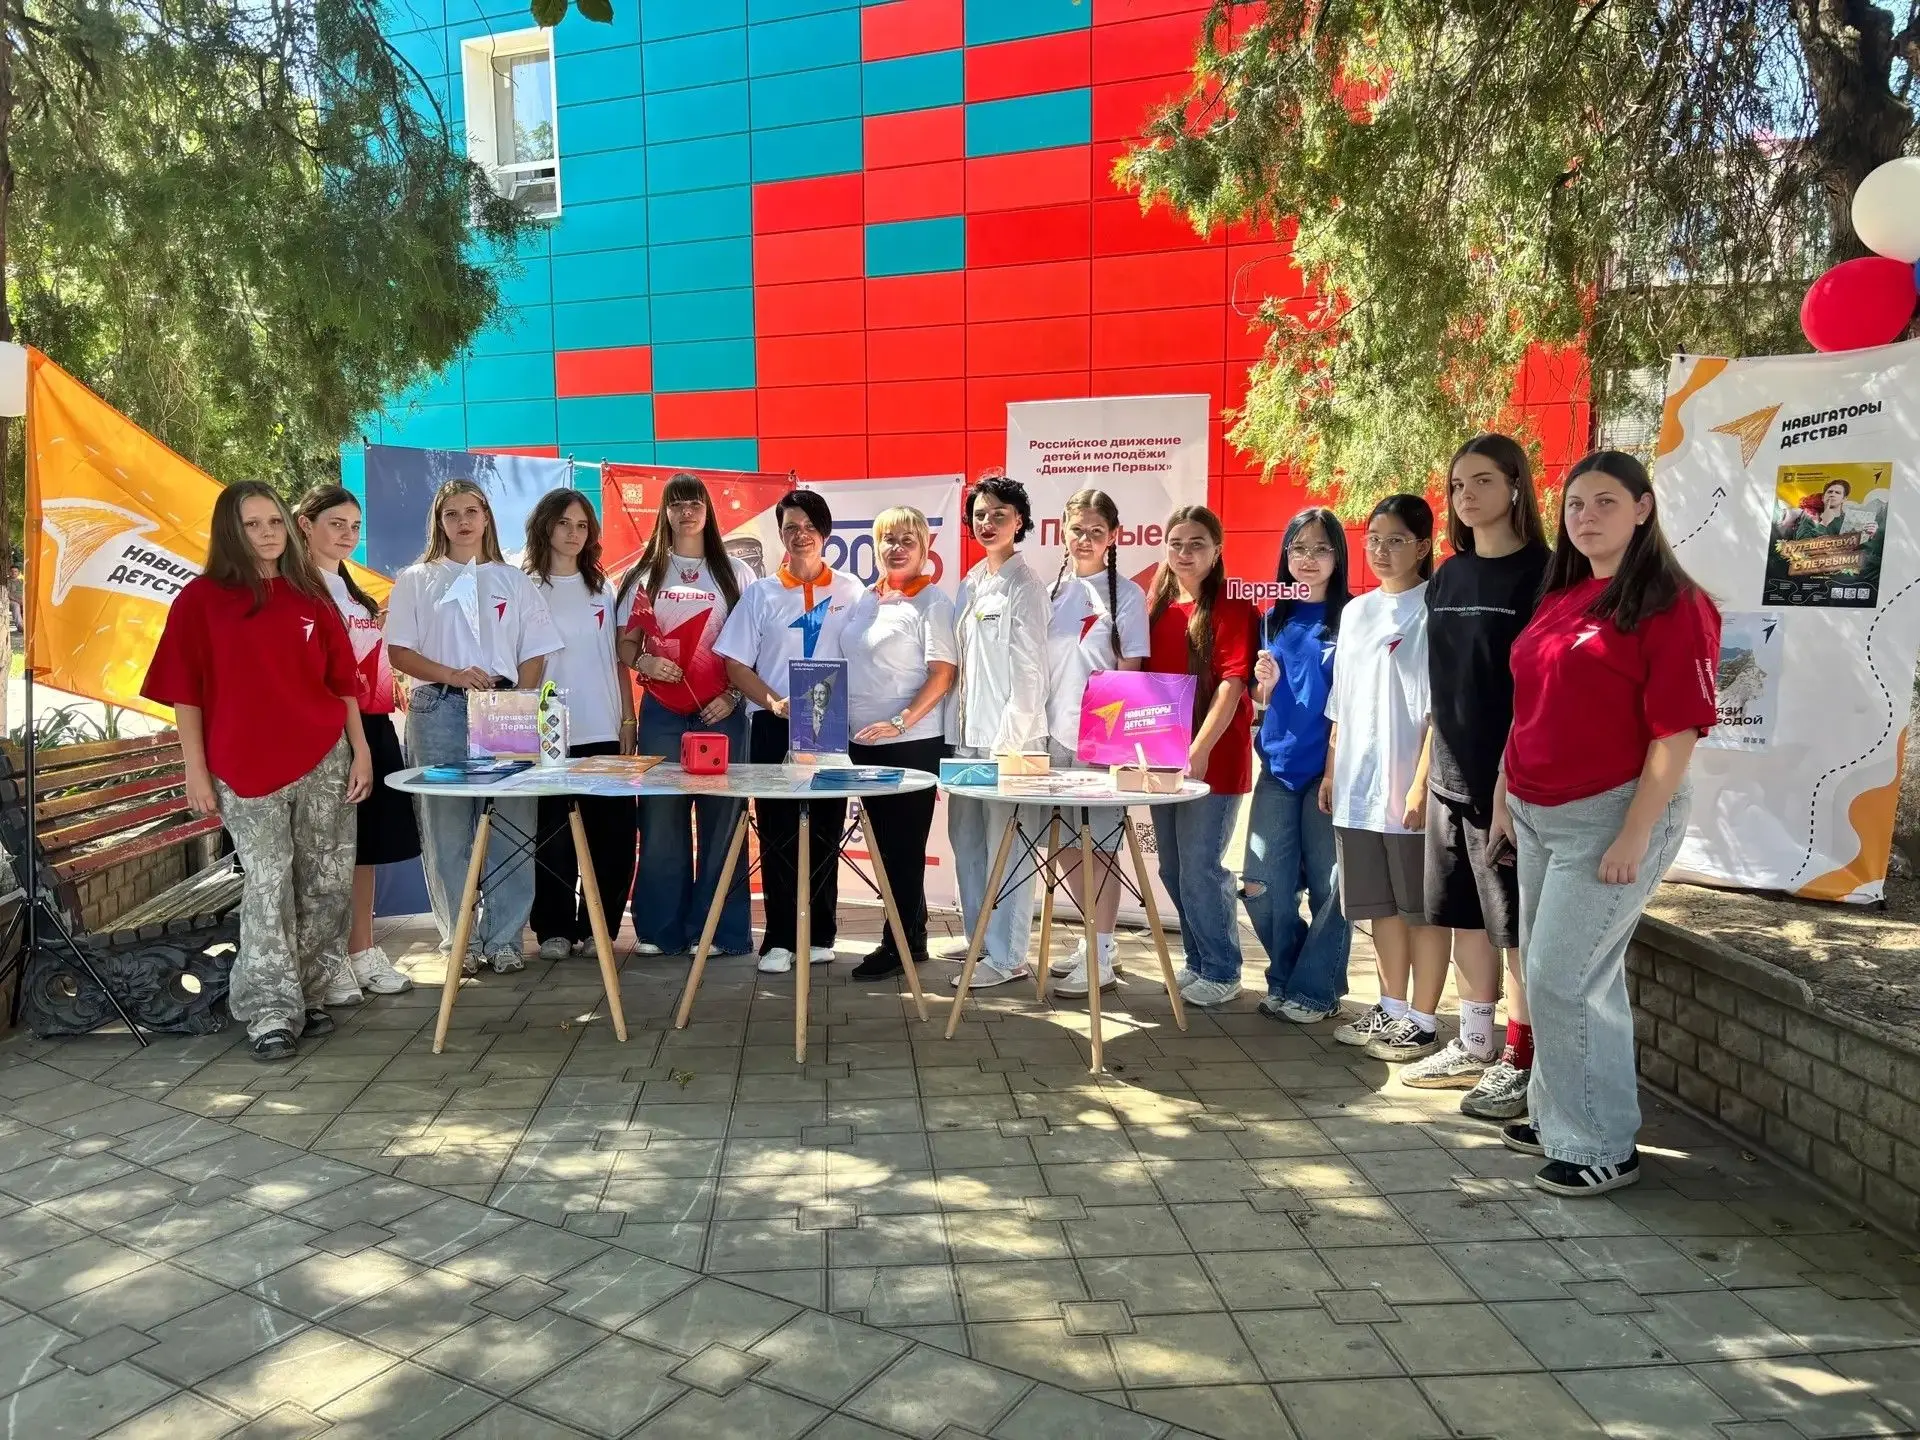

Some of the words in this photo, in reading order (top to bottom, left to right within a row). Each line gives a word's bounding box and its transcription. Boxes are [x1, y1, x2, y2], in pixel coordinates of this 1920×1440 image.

[1782, 401, 1882, 432] НАВИГАТОРЫ
[1029, 438, 1107, 450] Российское
[1110, 436, 1181, 447] движение
[1780, 423, 1848, 449] ДЕТСТВА
[1042, 451, 1080, 463] детей
[1093, 449, 1166, 461] молодёжи
[1036, 464, 1110, 475] «Движение
[1112, 462, 1172, 473] Первых»
[1040, 518, 1162, 546] Пые
[1784, 536, 1857, 554] ПУТЕШЕСТВУЙ
[1804, 555, 1859, 569] ПЕРВЫМИ
[658, 590, 715, 602] Первые
[1227, 578, 1310, 605] Первые
[1124, 718, 1156, 730] ДЕТСТВА
